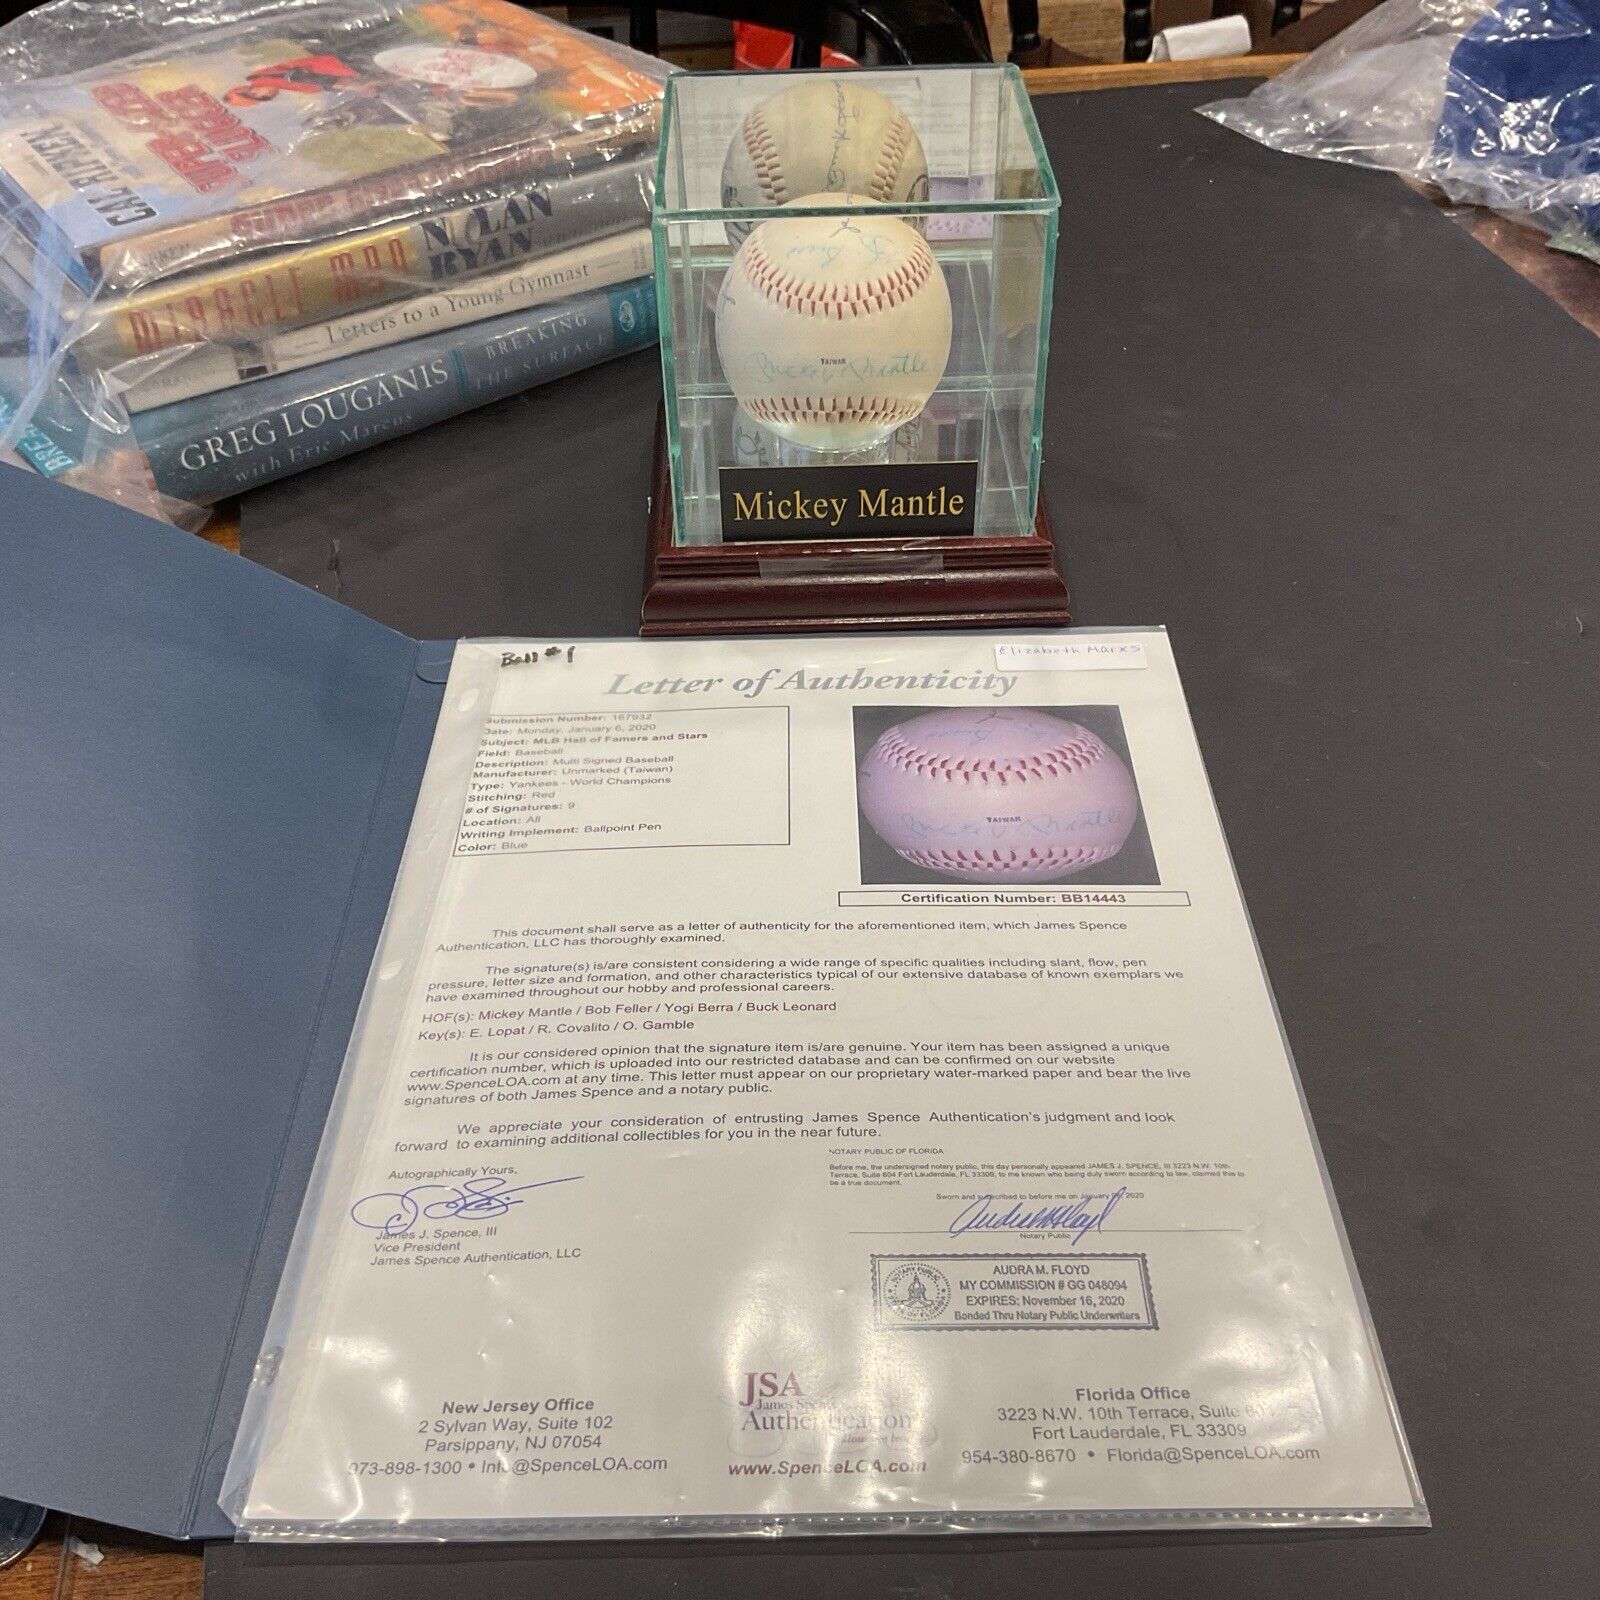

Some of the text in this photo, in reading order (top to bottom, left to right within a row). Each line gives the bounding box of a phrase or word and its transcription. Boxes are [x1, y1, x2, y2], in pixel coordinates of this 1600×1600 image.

[420, 188, 553, 252] NOLAN
[428, 227, 533, 281] RYAN
[326, 263, 591, 345] Letters to a Young Gymnast
[485, 314, 588, 360] BREAKING
[180, 360, 450, 472] GREG LOUGANIS
[234, 460, 282, 486] with
[734, 487, 965, 525] Mickey Mantle
[607, 667, 1018, 699] Letter of Authenticity
[480, 731, 708, 748] Subject: MLB Hall of Famers and Stars
[475, 755, 674, 770] Description: Multi Signed Baseball
[473, 765, 673, 778] Manufacturer: Unmarked (Taiwan)
[464, 802, 575, 814] # of Signatures: 9
[460, 822, 662, 841] Writing Implement: Ballpoint Pen
[458, 841, 528, 852] Color: Blue
[901, 893, 1126, 903] Certification Number: BB14443
[492, 928, 518, 938] This
[521, 925, 584, 937] document
[587, 924, 616, 934] shall
[620, 925, 654, 933] serve
[658, 924, 673, 932] as
[688, 921, 720, 931] letter
[724, 921, 736, 930] of
[739, 921, 810, 932] authenticity
[814, 921, 831, 930] for
[834, 921, 854, 930] the
[858, 921, 955, 930] aforementioned
[959, 921, 990, 931] item,
[993, 921, 1030, 930] which
[1034, 921, 1075, 930] James
[1079, 921, 1127, 932] Spence
[422, 1001, 837, 1026] HOF(s): Mickey Mantle Bob Feller Yogi Berra Buck Leonard
[418, 1019, 694, 1042] Key(s): E. Lopat R. Covalito O. Gamble
[389, 1166, 518, 1182] Autographically Yours,
[420, 1229, 431, 1238] J.
[433, 1228, 482, 1240] Spence,
[485, 1227, 497, 1236] III
[373, 1242, 460, 1252] Vice President
[370, 1249, 581, 1267] James Spence Authentication, LLC
[993, 1264, 1090, 1275] AUDRA M. FLOYD
[960, 1280, 1127, 1290] MY COMMISSION # GG 048094
[966, 1296, 1124, 1307] EXPIRES: November 16, 2020
[954, 1311, 1140, 1322] Bonded Thru Notary Public Underwriters
[739, 1371, 804, 1407] JSA
[1076, 1387, 1190, 1401] Florida Office
[442, 1399, 594, 1416] New Jersey Office
[997, 1407, 1037, 1421] 3223
[1041, 1407, 1082, 1420] N.W.
[1088, 1406, 1122, 1420] 10th
[1126, 1405, 1195, 1421] Terrace,
[418, 1416, 613, 1436] 2 Sylvan Way, Suite 102
[1032, 1423, 1247, 1441] Fort Lauderdale, FL 33309
[425, 1435, 602, 1455] Parsippany, NJ 07054
[961, 1447, 1320, 1465] 954-380-8670 Florida@SpenceLOA.com
